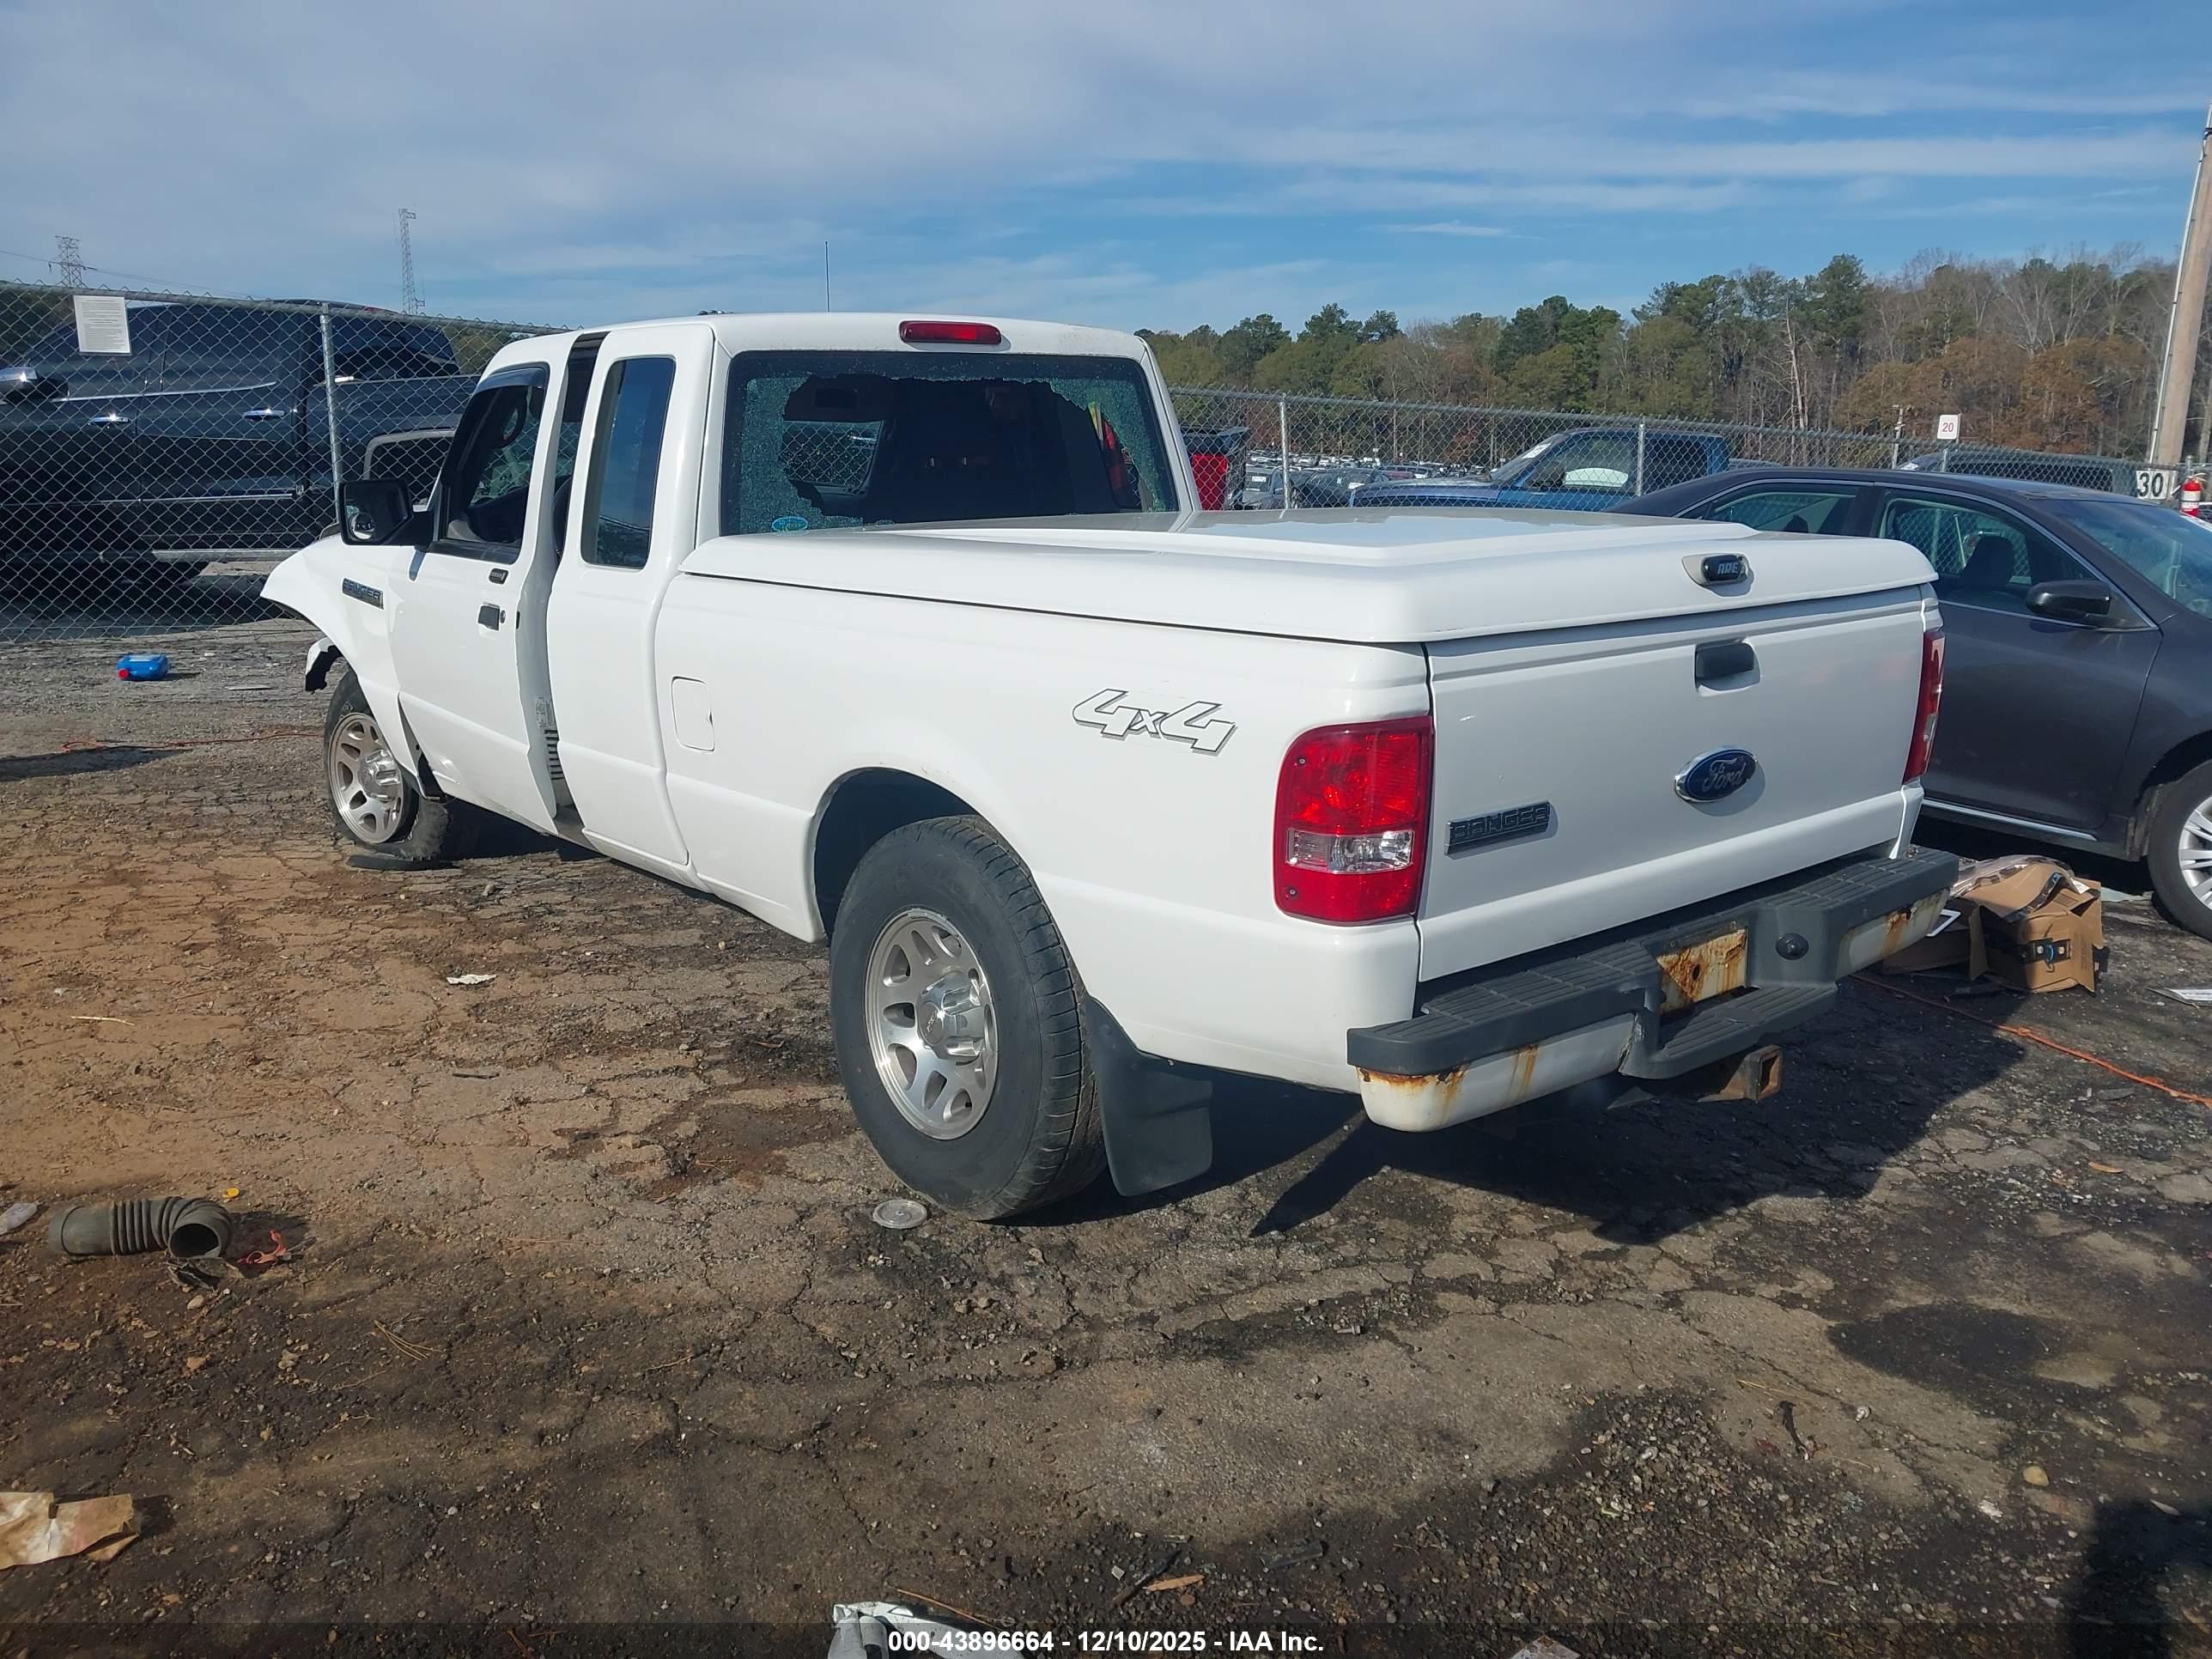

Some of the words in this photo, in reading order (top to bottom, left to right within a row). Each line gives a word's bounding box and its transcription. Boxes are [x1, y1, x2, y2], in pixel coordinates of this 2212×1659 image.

[1942, 422, 1954, 433] 20
[2138, 472, 2164, 497] 30
[1073, 688, 1237, 756] 4x4
[1702, 757, 1747, 792] Ford
[1453, 805, 1547, 842] RANGER
